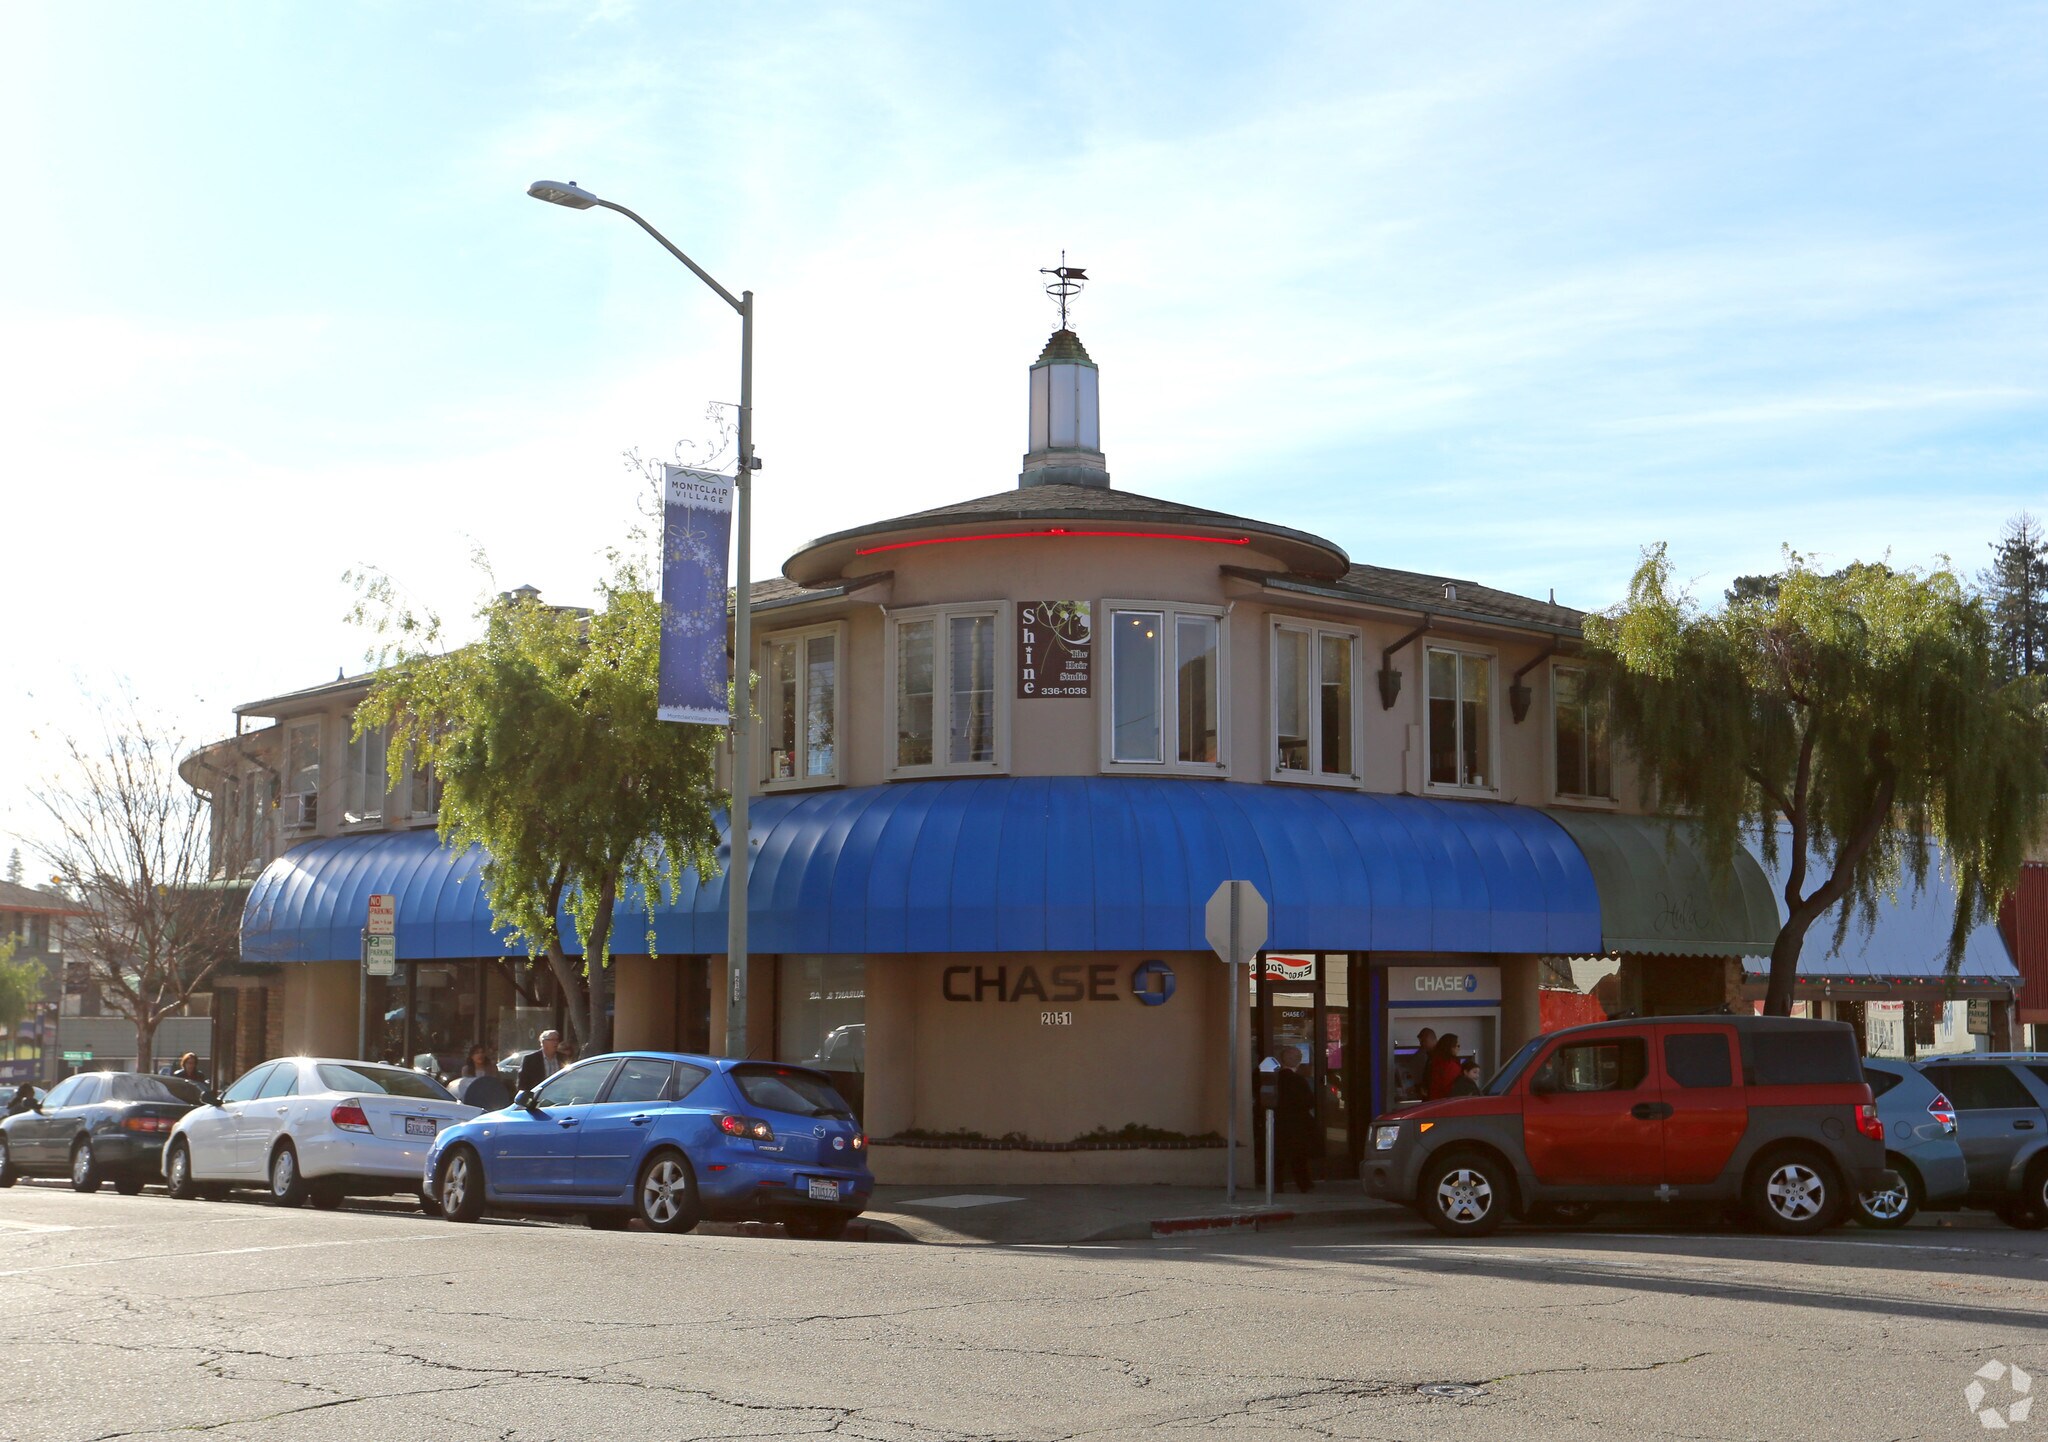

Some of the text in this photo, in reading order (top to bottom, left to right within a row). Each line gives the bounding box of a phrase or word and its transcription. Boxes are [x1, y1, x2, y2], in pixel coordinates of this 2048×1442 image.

[671, 481, 728, 496] MONTCLAIR
[676, 490, 724, 503] VILLAGE
[1071, 649, 1088, 658] The
[1065, 660, 1088, 670] Hair
[1059, 672, 1088, 681] Studio
[1041, 687, 1087, 695] 336-1036
[370, 895, 381, 906] NO
[371, 937, 378, 946] 2
[370, 948, 393, 956] PARKING
[943, 964, 1120, 1002] CHASE
[1414, 976, 1463, 991] CHASE
[1969, 1000, 1975, 1008] 2
[1042, 1012, 1072, 1025] 2051
